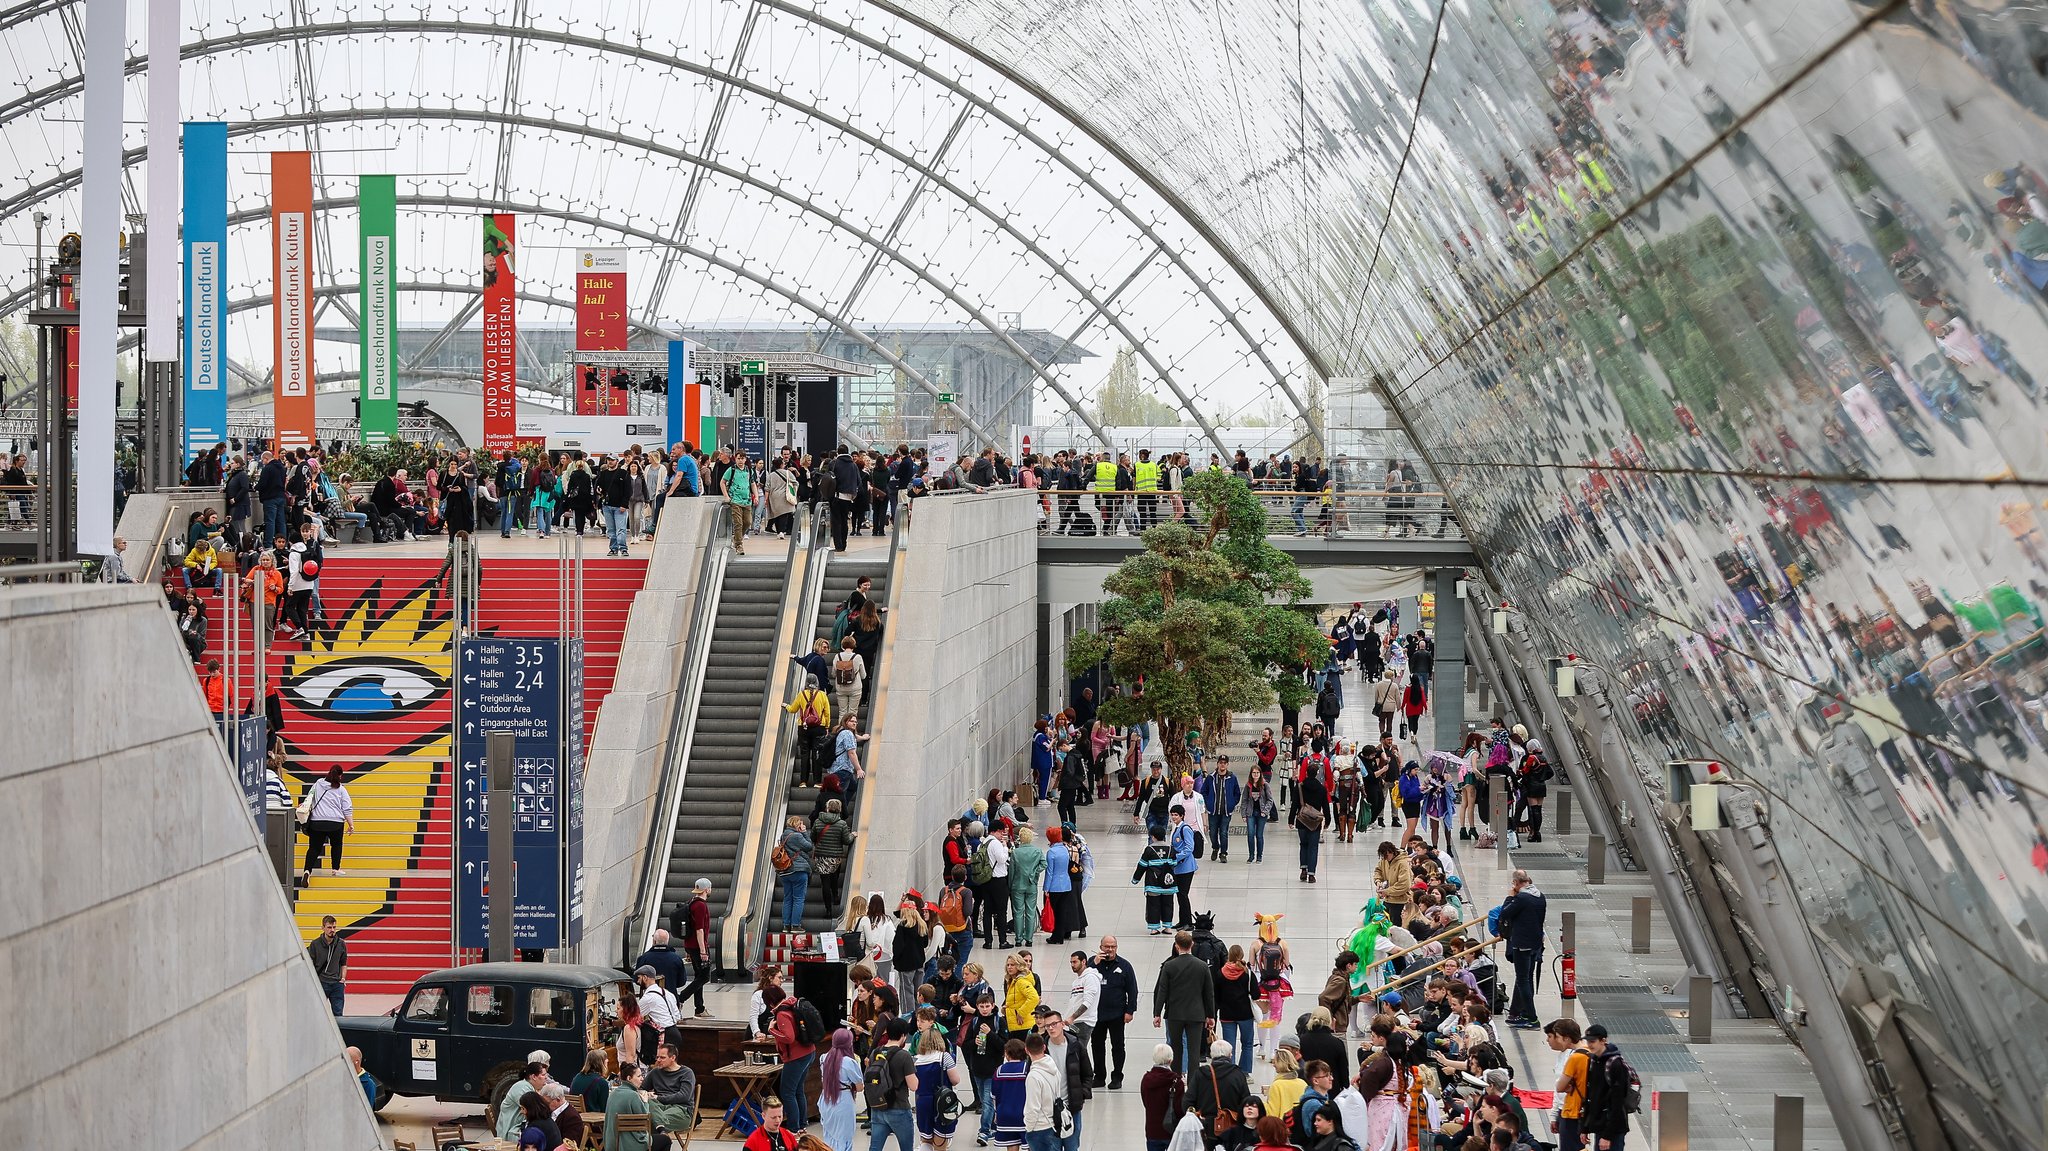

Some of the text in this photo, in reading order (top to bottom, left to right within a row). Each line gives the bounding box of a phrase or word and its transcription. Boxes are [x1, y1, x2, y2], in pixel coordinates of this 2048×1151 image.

[584, 278, 614, 288] Halle
[584, 294, 606, 304] hall
[286, 218, 300, 392] Deutschlandfunk Kultur
[198, 246, 212, 384] Deutschlandfunk
[373, 240, 385, 396] Deutschlandfunk Nova
[500, 297, 511, 418] SIE AM LIEBSTEN?
[486, 313, 498, 417] UND WO LESEN
[486, 440, 514, 448] Lounge
[480, 646, 544, 668] Hallen 3,5
[480, 656, 499, 665] Halls
[480, 670, 544, 692] Hallen 2,4
[480, 680, 499, 689] Halls
[480, 694, 524, 704] Freigelände
[480, 705, 511, 713] Outdoor
[480, 719, 548, 728] Eingangshalle Ost
[515, 729, 548, 737] Hall East
